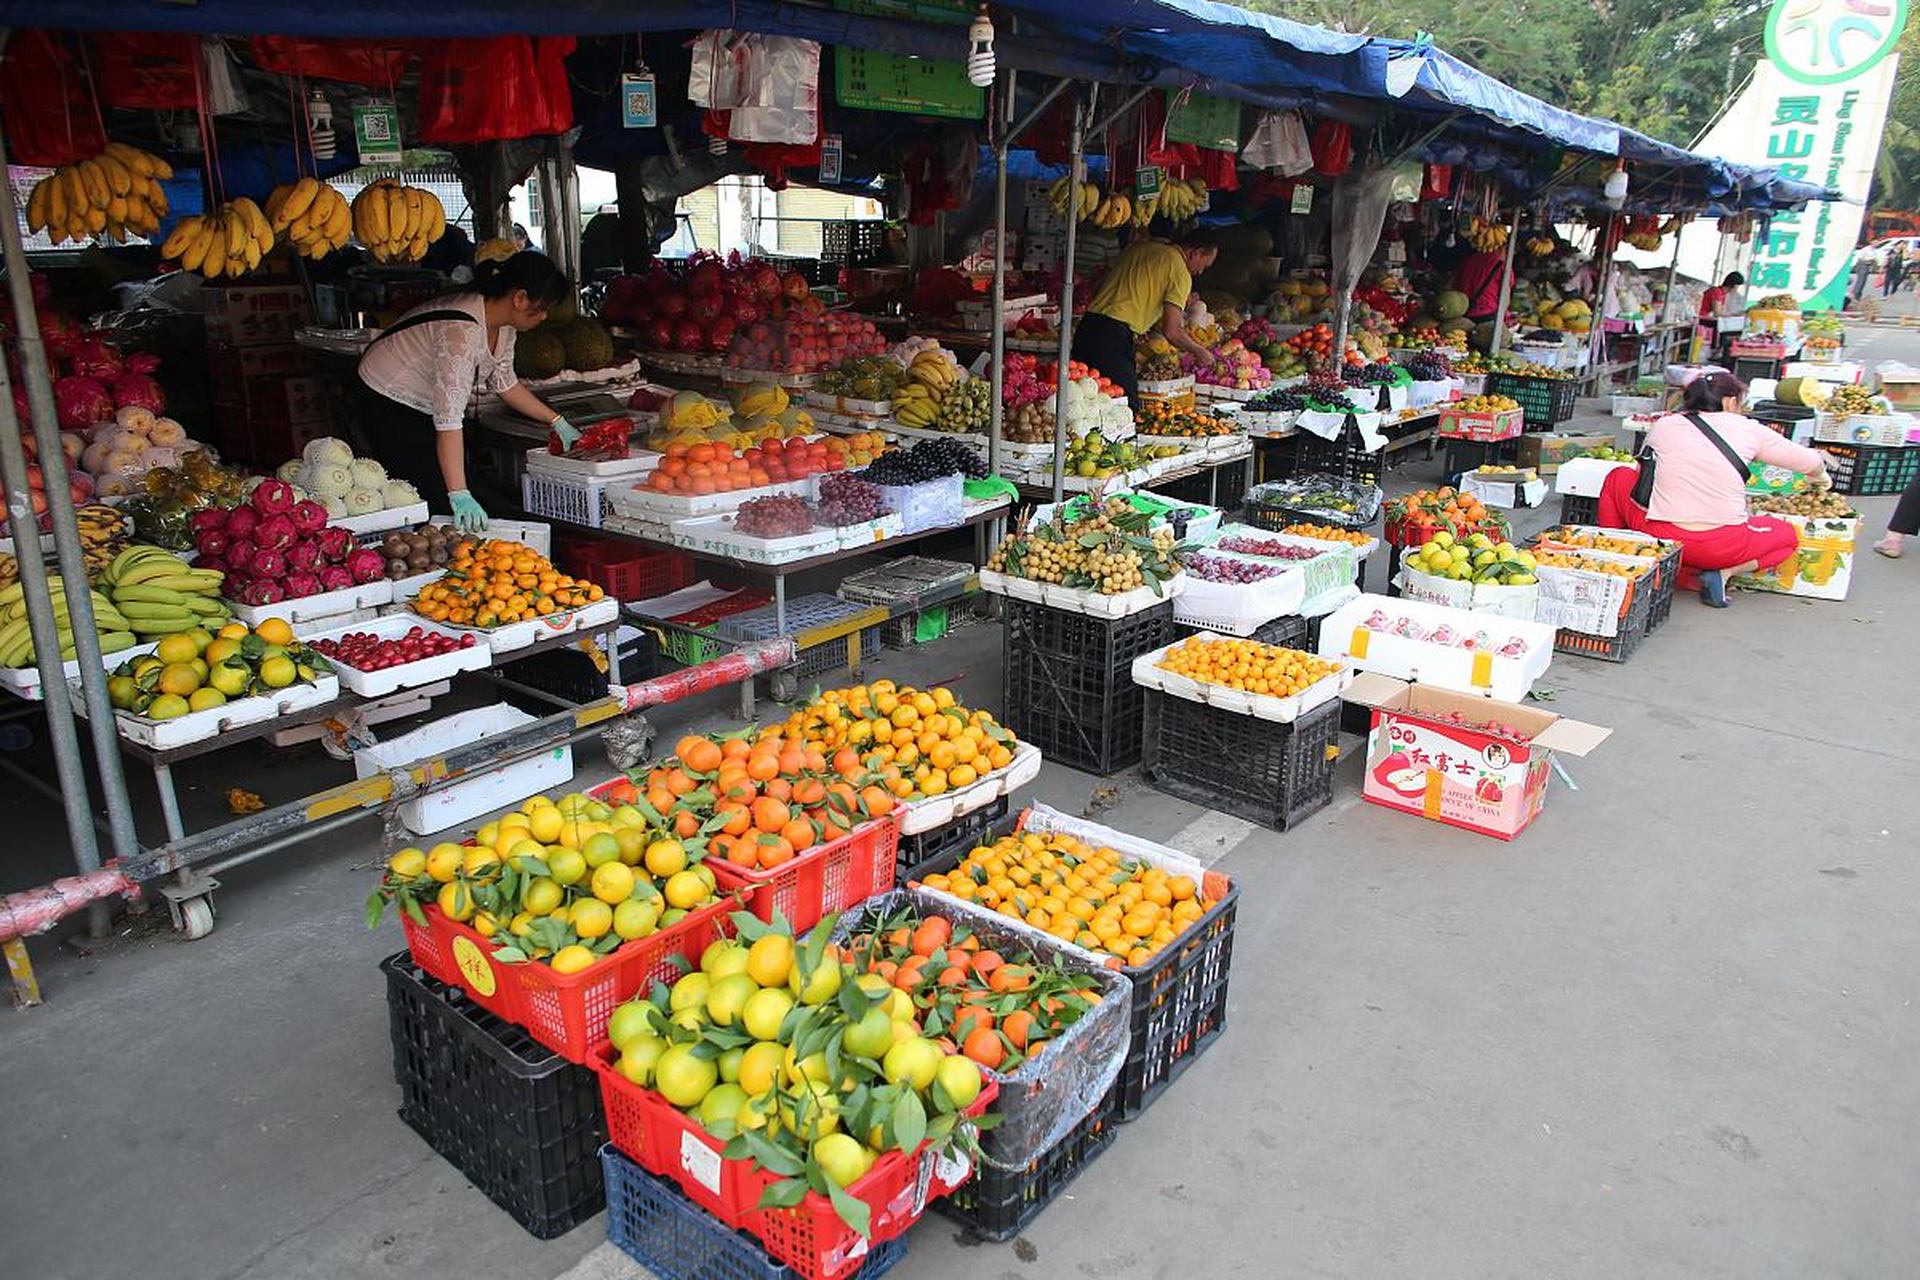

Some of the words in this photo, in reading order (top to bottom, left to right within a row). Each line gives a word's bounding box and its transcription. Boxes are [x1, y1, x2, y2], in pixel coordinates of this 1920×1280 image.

[1836, 89, 1860, 119] Ling
[1412, 747, 1475, 775] 红富士
